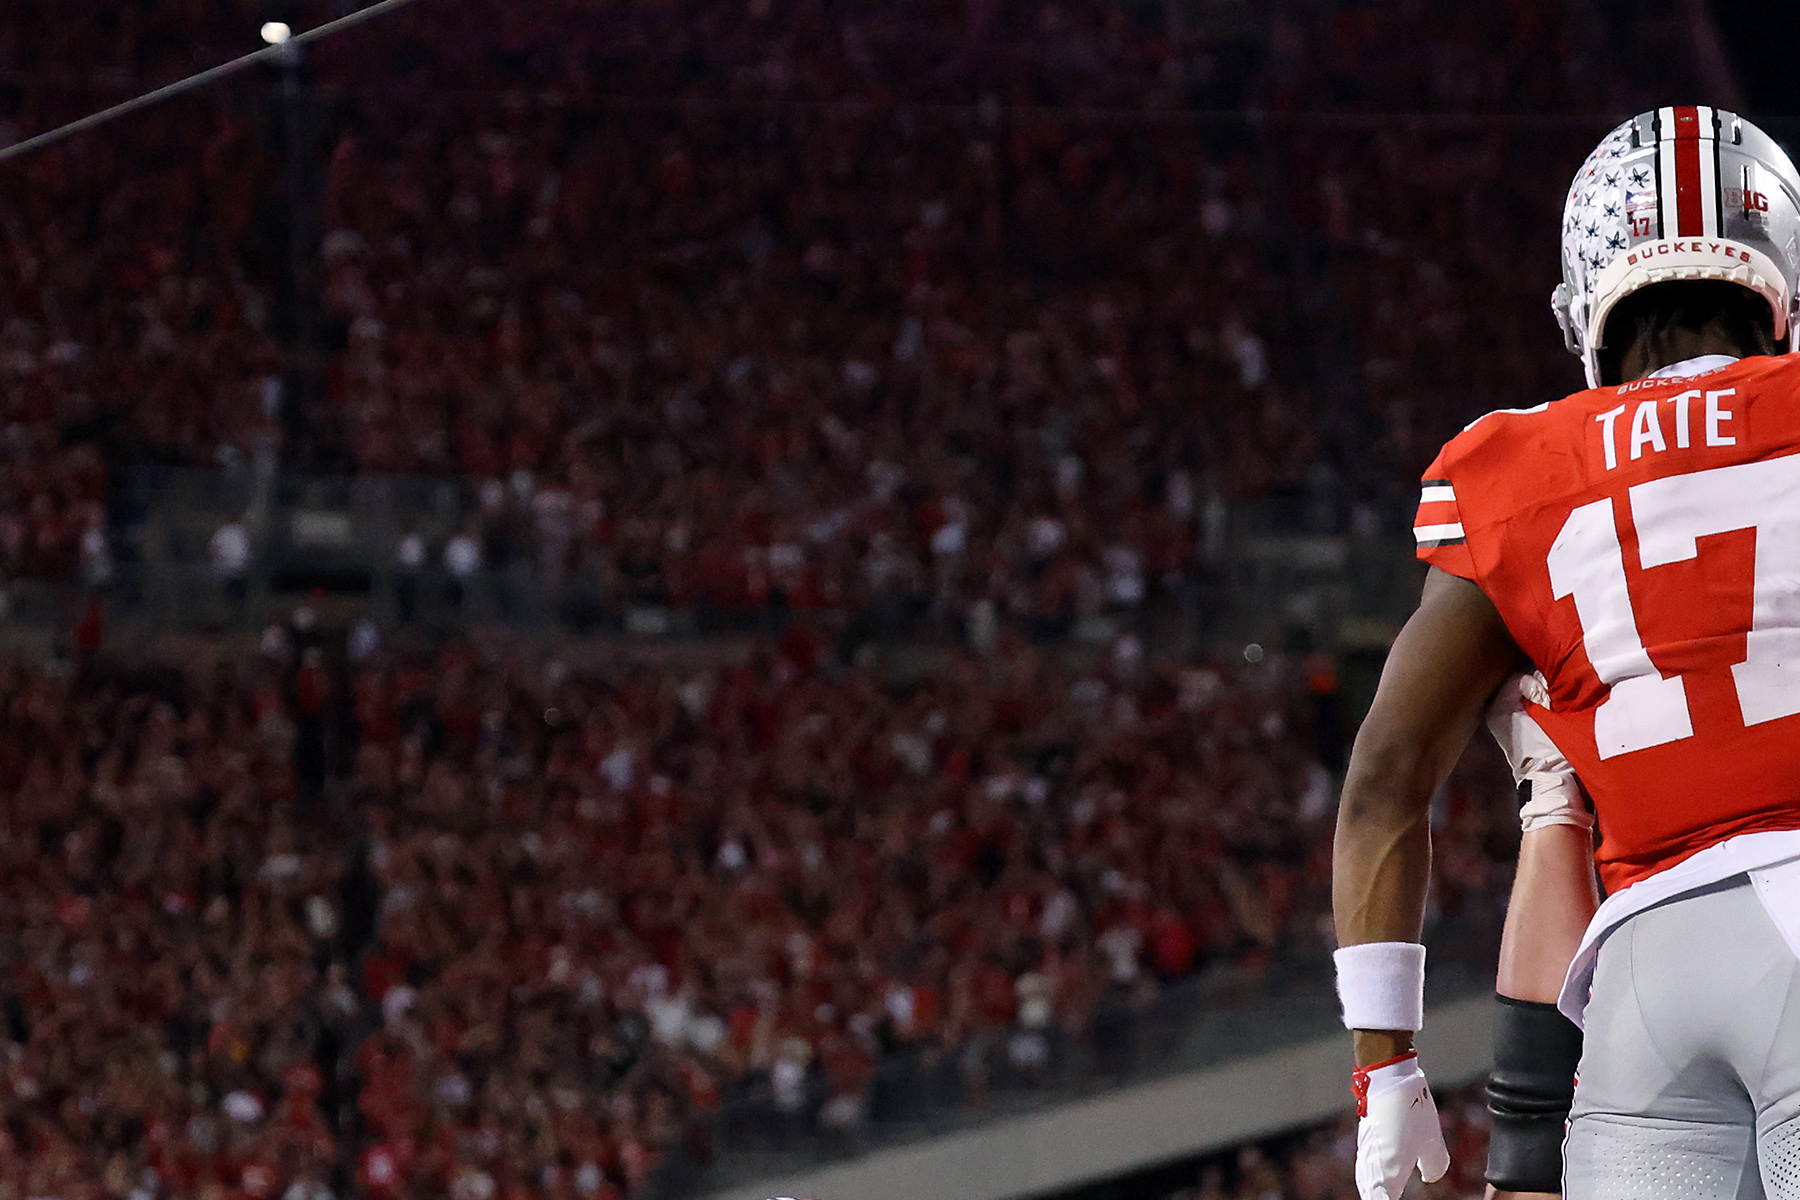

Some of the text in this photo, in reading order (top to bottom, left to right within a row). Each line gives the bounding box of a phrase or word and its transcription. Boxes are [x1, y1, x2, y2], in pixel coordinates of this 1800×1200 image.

[1631, 217, 1650, 237] 17
[1627, 242, 1752, 266] BUCKEYES
[1595, 388, 1736, 471] TATE
